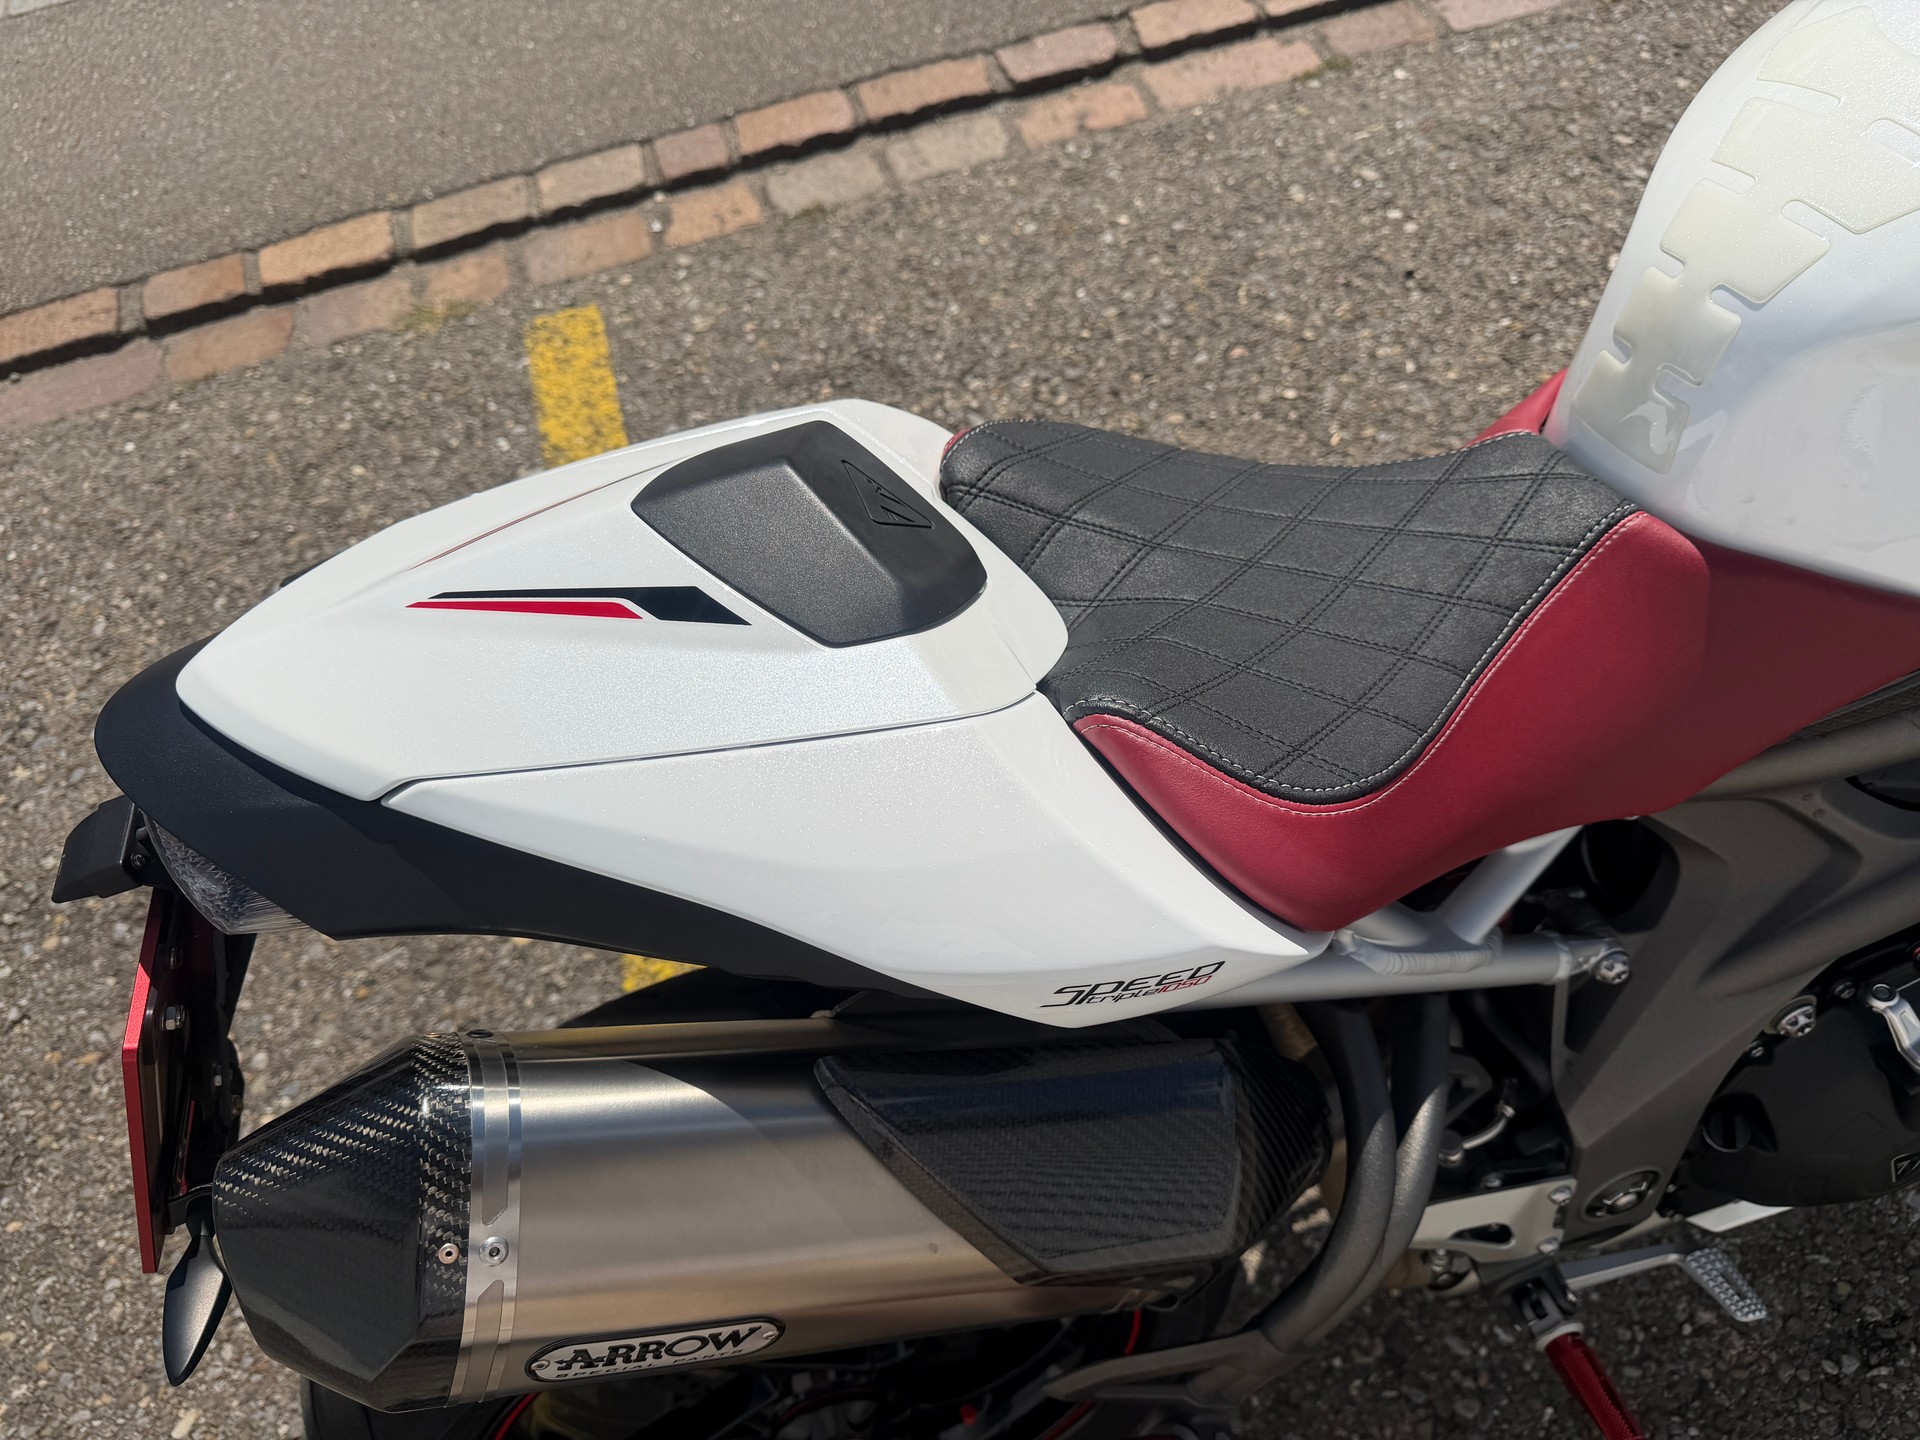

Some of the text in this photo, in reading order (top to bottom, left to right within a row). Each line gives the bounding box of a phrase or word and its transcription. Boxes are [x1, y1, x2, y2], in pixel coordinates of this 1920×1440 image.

[1040, 960, 1226, 1008] SPEED
[554, 1325, 763, 1371] ARROW
[554, 1348, 744, 1379] SPECIAL PARTS
